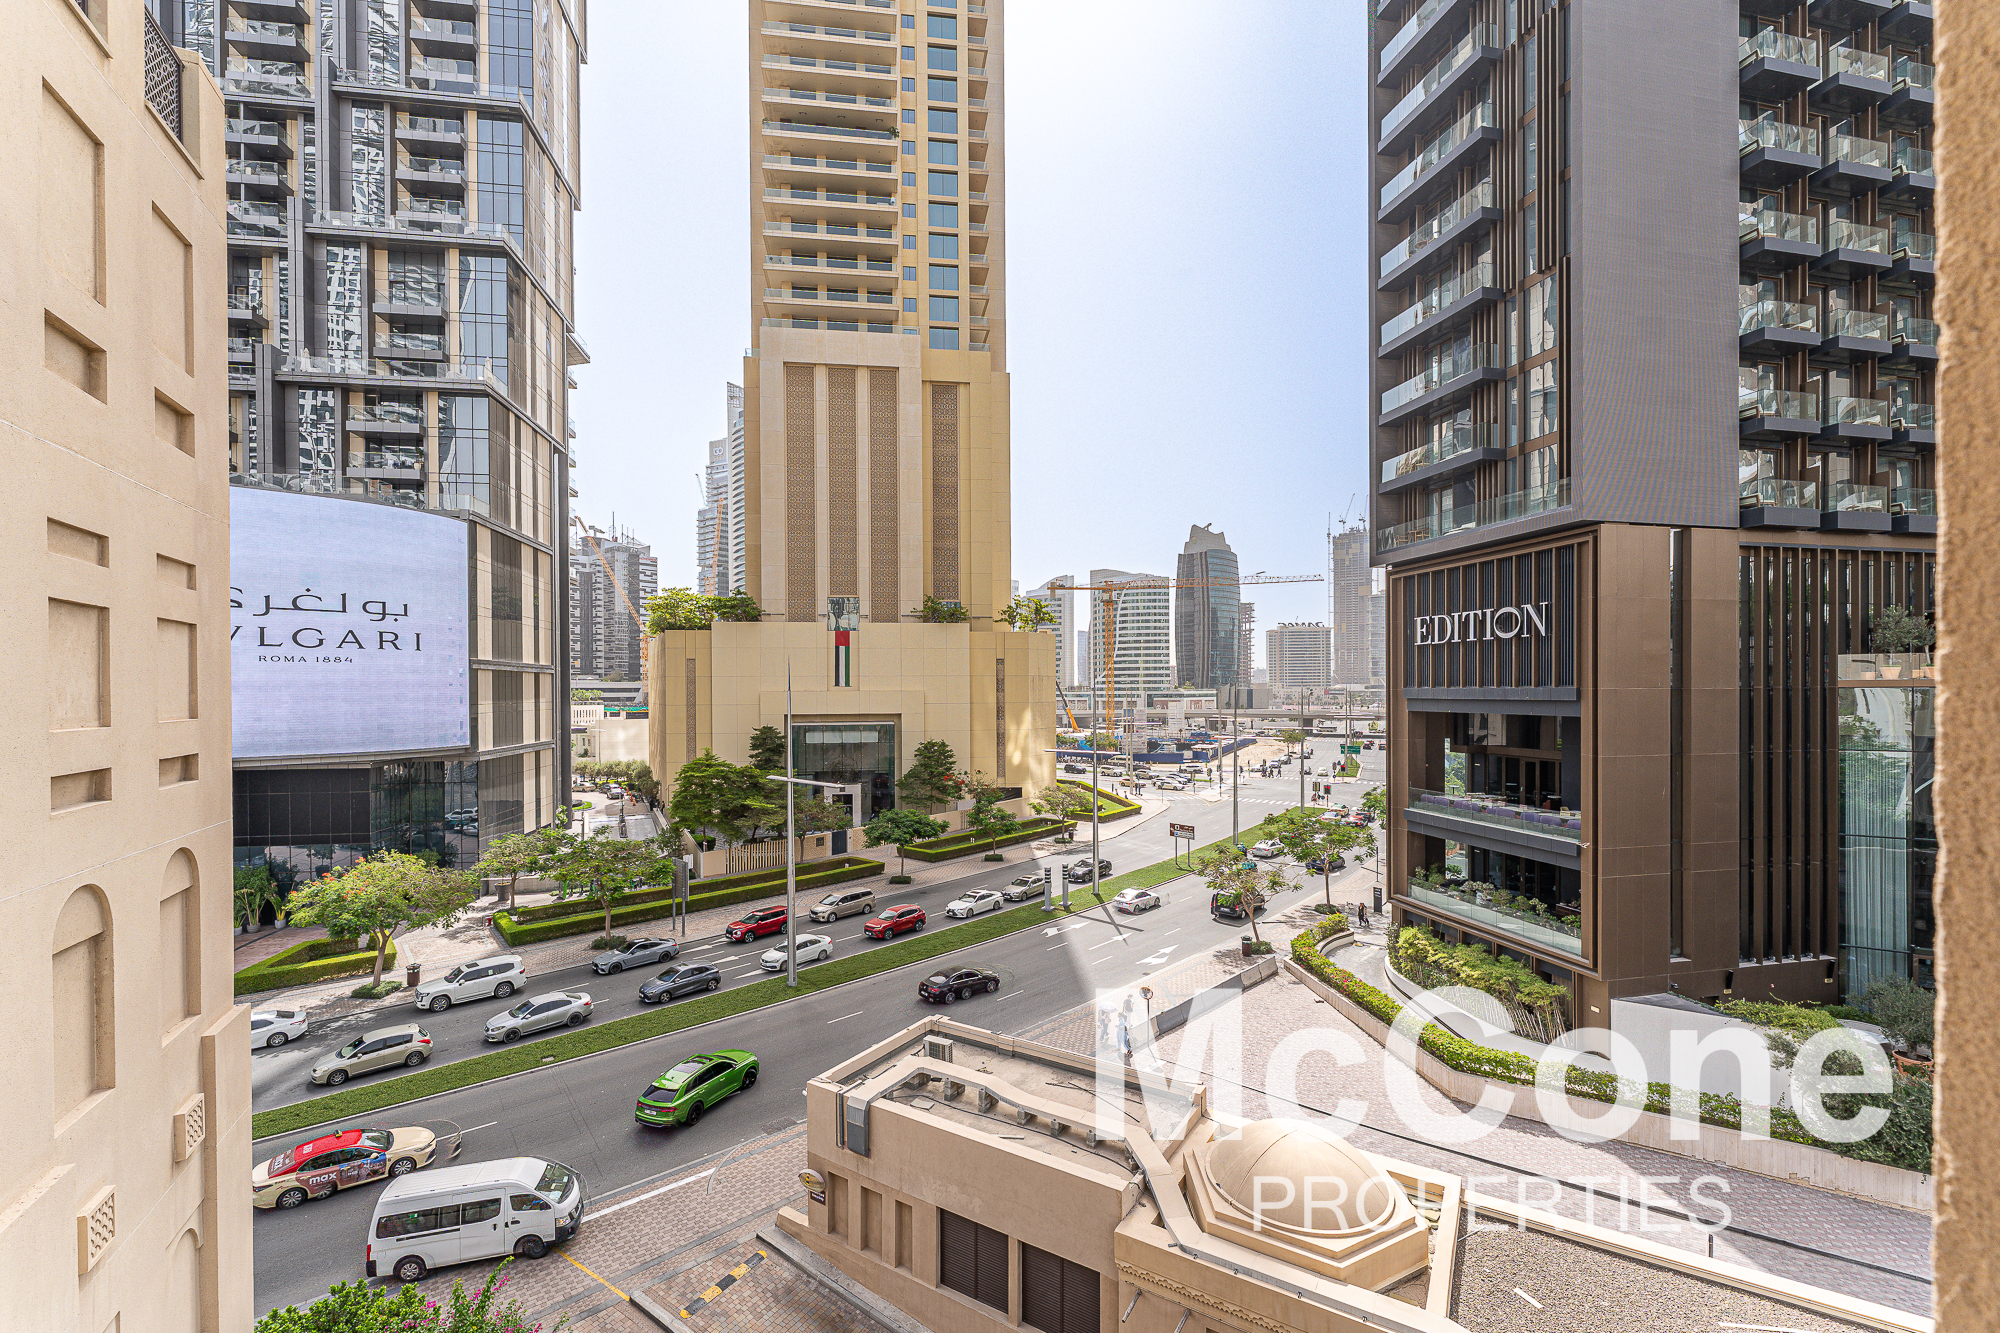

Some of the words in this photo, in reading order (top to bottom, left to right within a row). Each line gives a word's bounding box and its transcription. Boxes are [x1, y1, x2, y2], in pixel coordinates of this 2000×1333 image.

[1414, 601, 1552, 646] EDITION
[258, 655, 307, 663] ROMA
[316, 655, 353, 664] 1884
[309, 1171, 337, 1185] max
